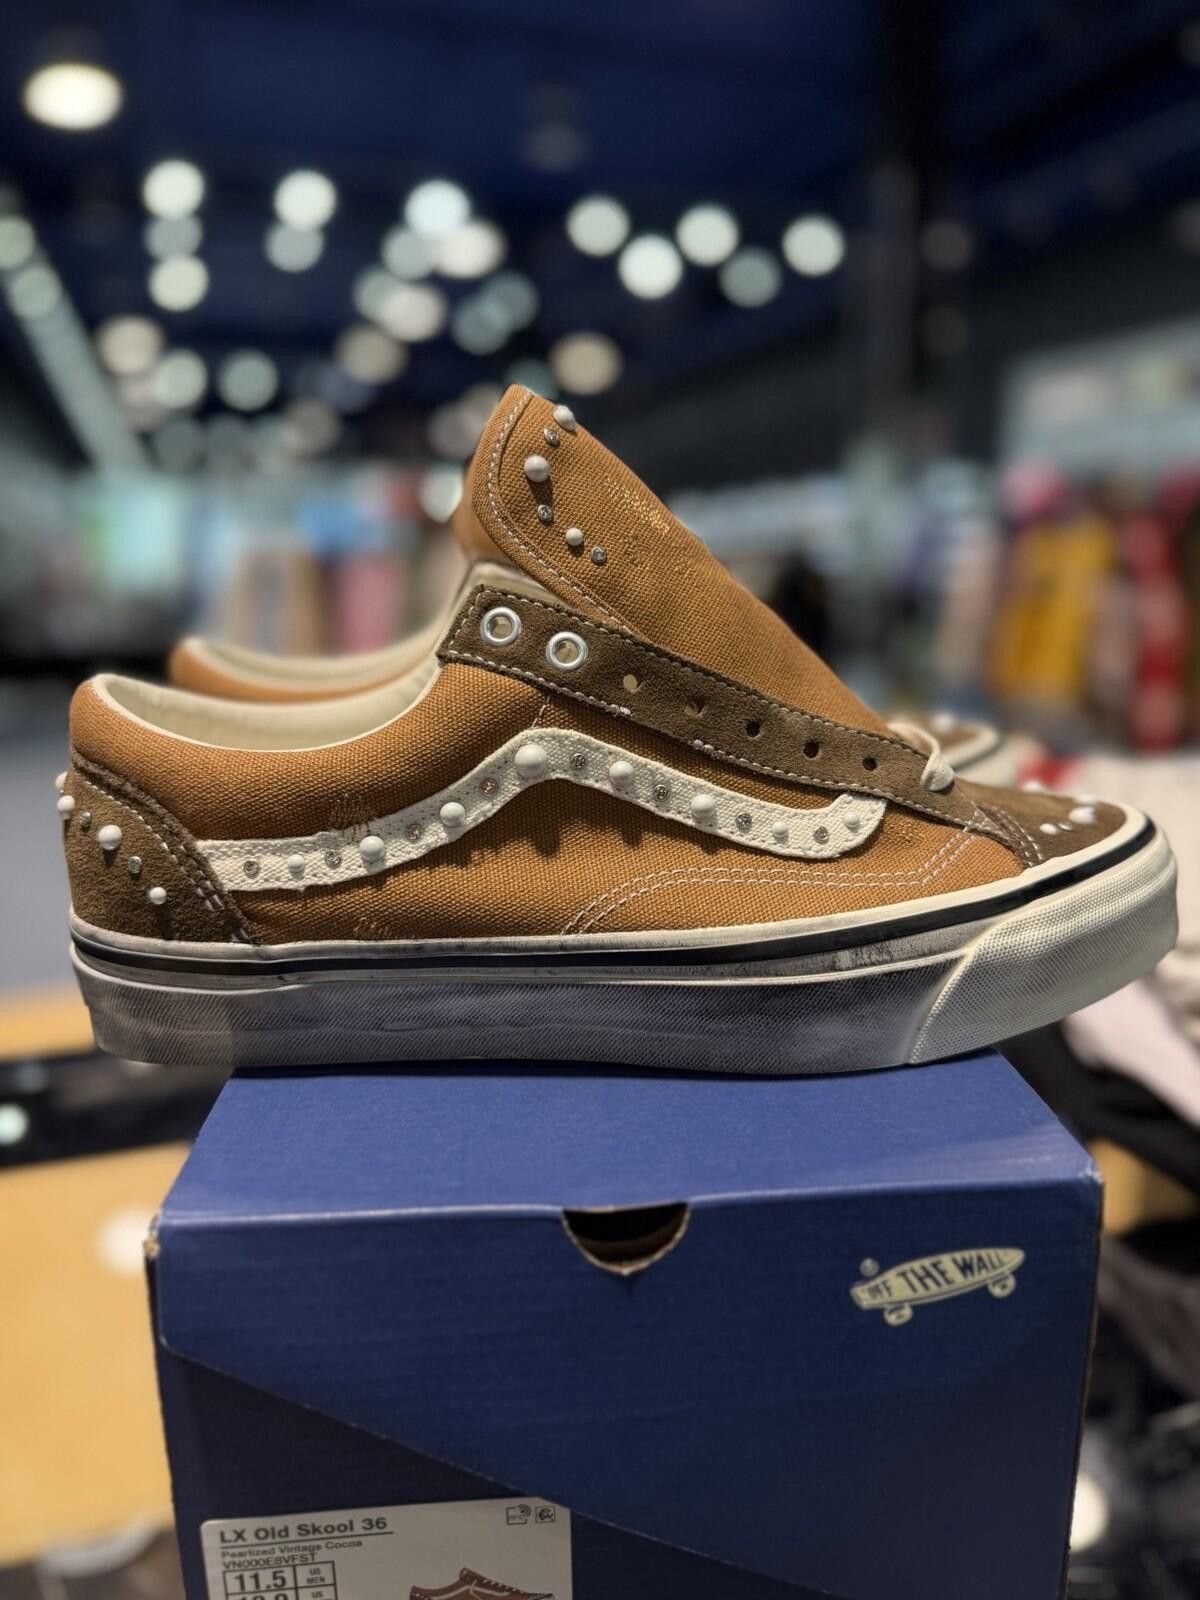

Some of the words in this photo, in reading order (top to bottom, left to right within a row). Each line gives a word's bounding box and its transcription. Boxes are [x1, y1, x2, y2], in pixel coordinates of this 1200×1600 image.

[896, 1259, 955, 1294] THE
[951, 1251, 1005, 1280] WALL
[219, 1528, 248, 1544] LX
[253, 1525, 290, 1541] Old
[296, 1518, 355, 1537] Skool
[361, 1516, 388, 1532] 36
[278, 1543, 323, 1554] Vintage
[324, 1540, 363, 1550] Cocoa
[306, 1576, 326, 1585] MEN
[309, 1567, 322, 1576] US
[234, 1570, 287, 1592] 11.5
